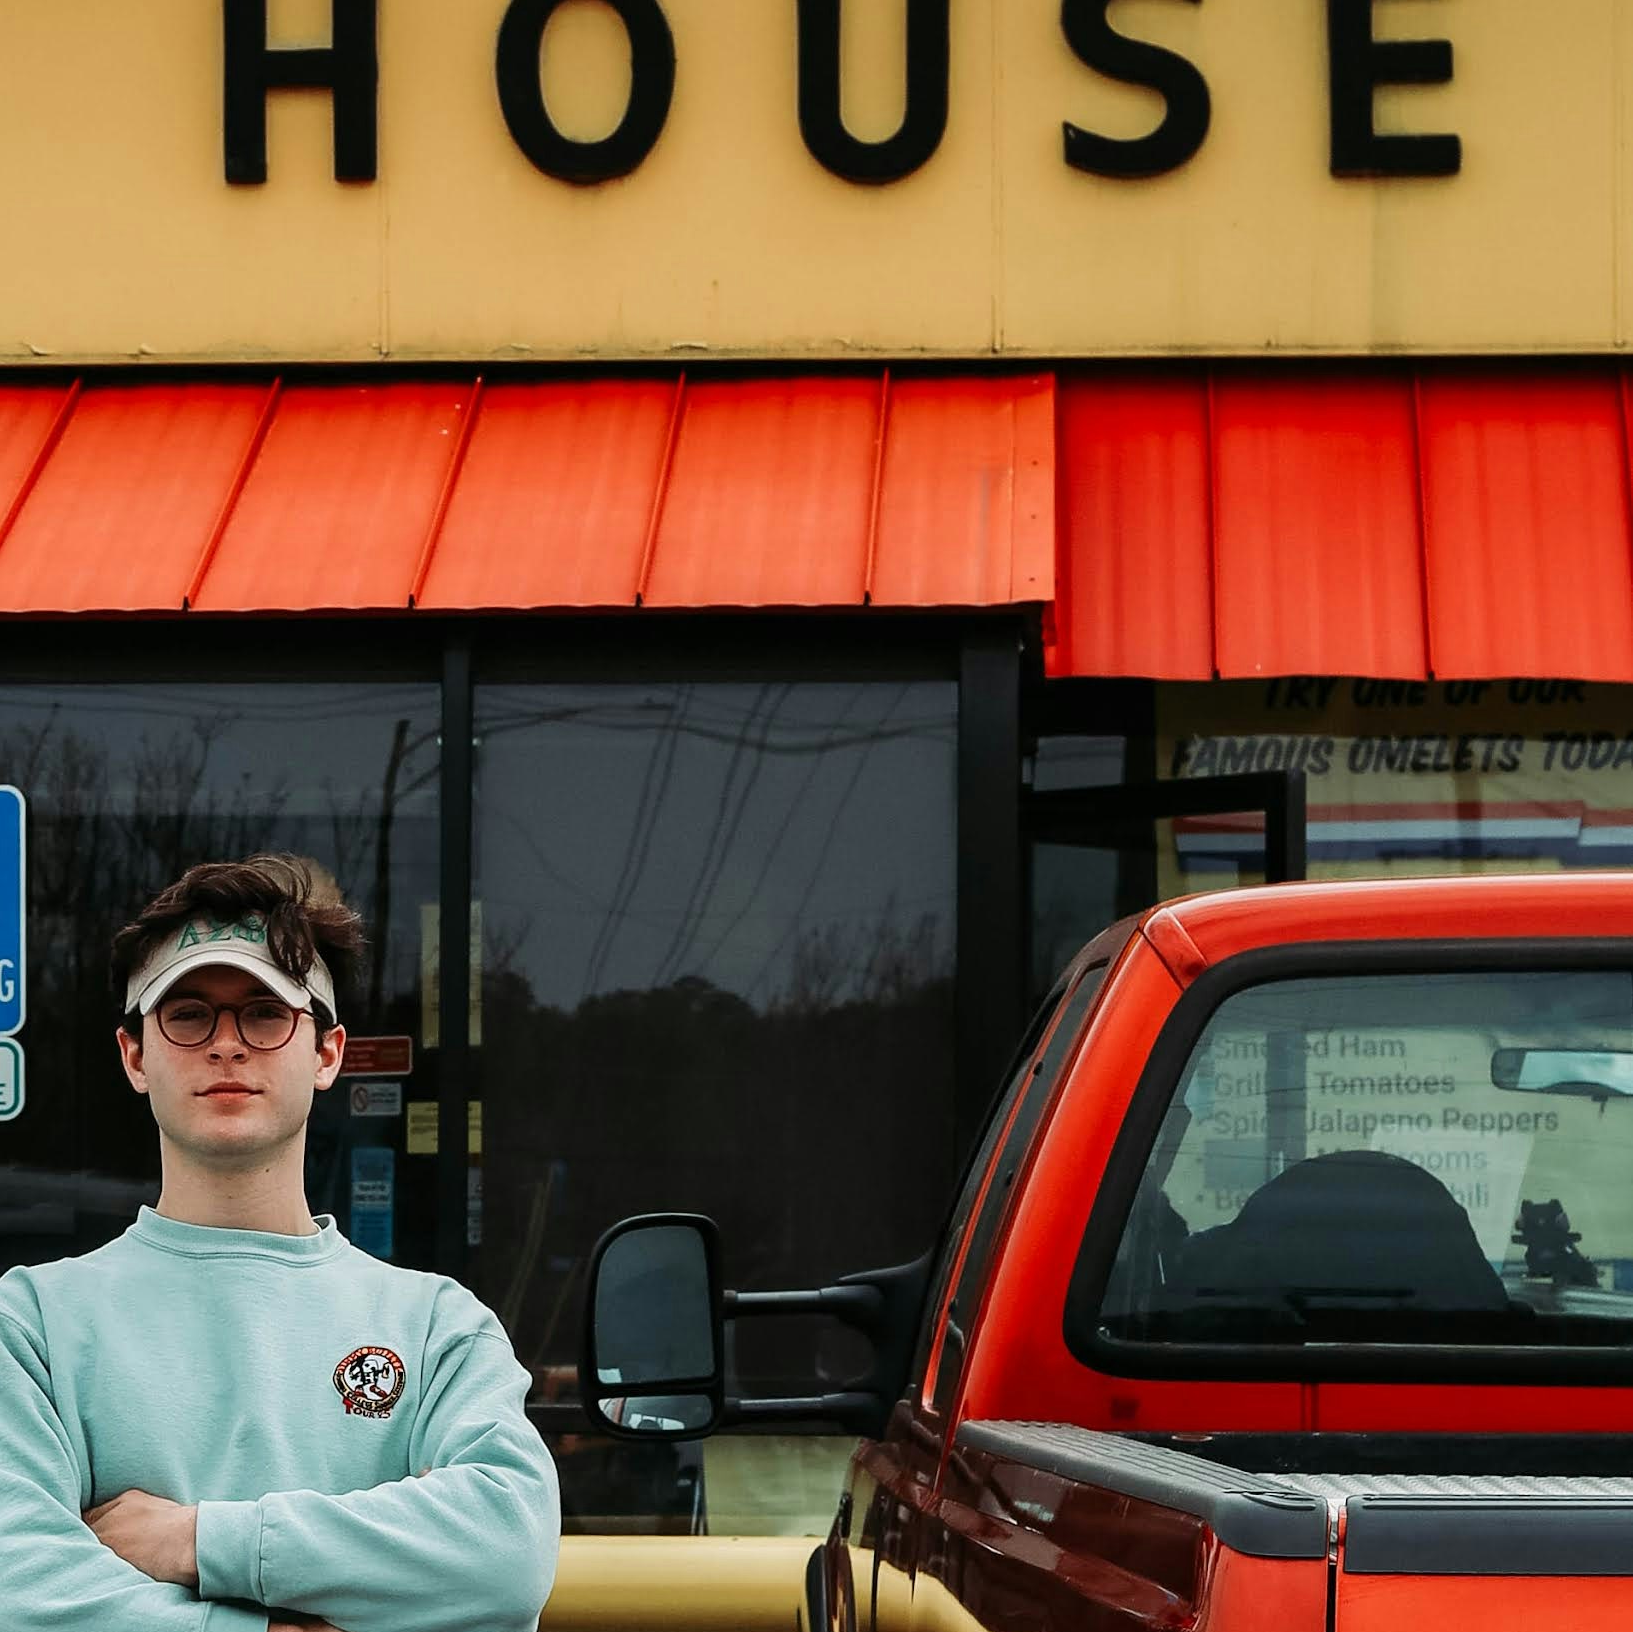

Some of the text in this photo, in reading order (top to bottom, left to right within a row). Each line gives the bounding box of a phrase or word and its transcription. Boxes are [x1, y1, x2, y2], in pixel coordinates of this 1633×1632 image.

[1265, 677, 1587, 710] TRY ONE OF OUR
[1170, 733, 1334, 777] FAMOUS
[1347, 731, 1525, 773] OMELETS
[1339, 1034, 1407, 1059] Ham
[1317, 1071, 1456, 1096] Tomatoes
[1306, 1107, 1433, 1135] Jalapeno
[1442, 1106, 1560, 1135] Peppers
